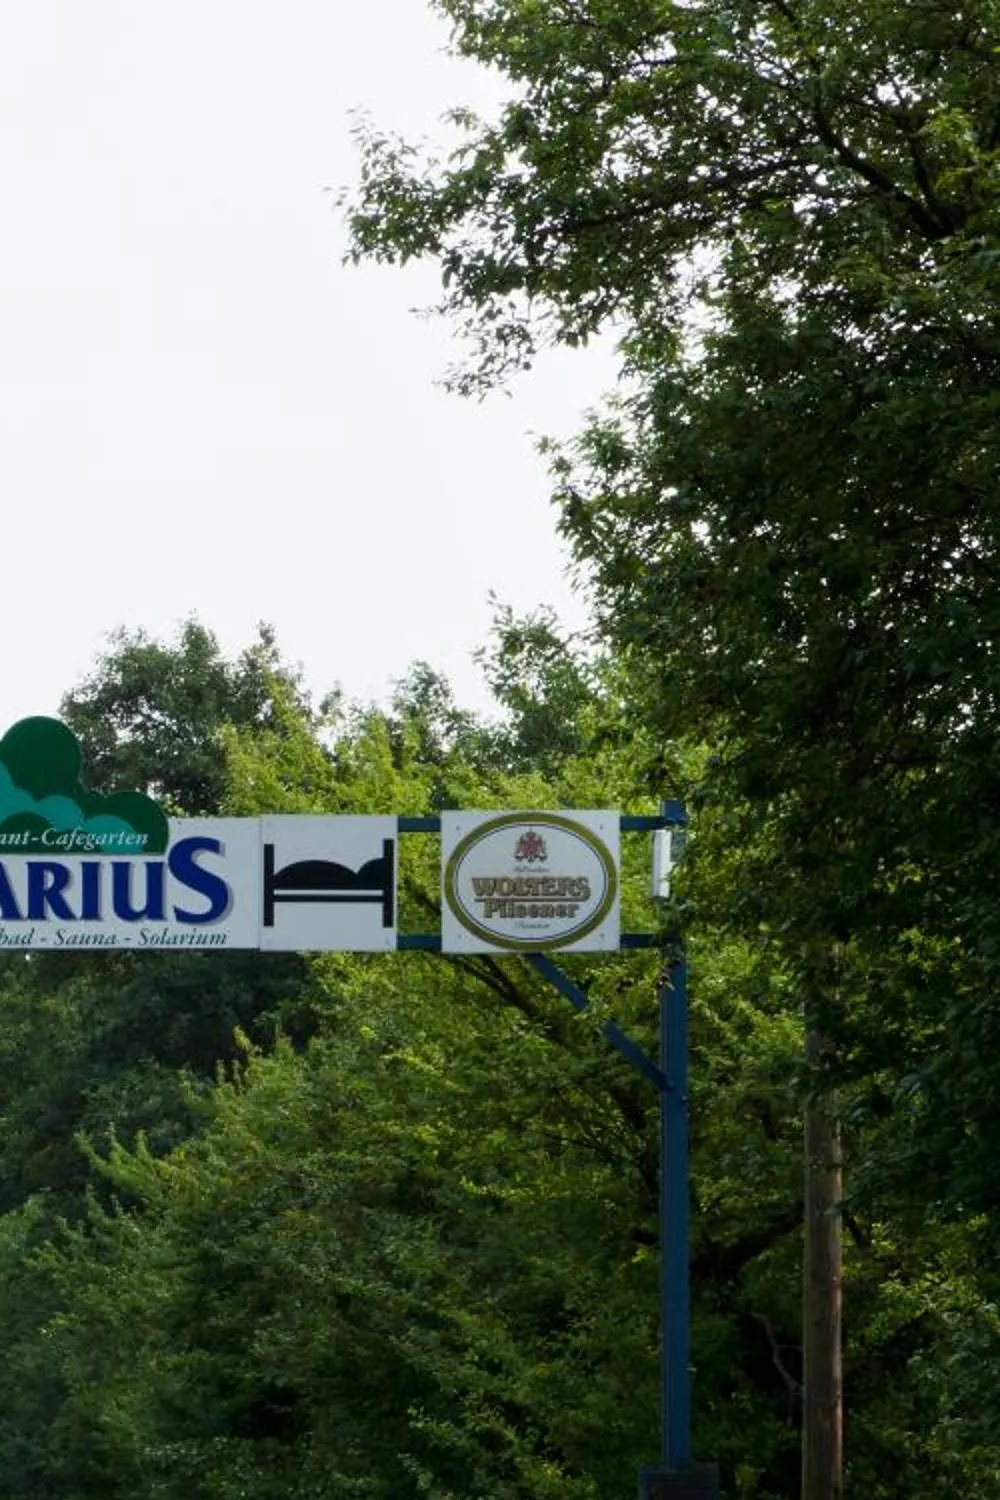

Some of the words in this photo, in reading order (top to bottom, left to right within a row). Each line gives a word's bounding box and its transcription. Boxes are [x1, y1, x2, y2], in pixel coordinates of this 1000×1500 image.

[471, 876, 591, 902] WOLTERS
[483, 899, 580, 918] Pilsener
[54, 928, 117, 946] Sauna
[137, 928, 229, 946] Solarium
